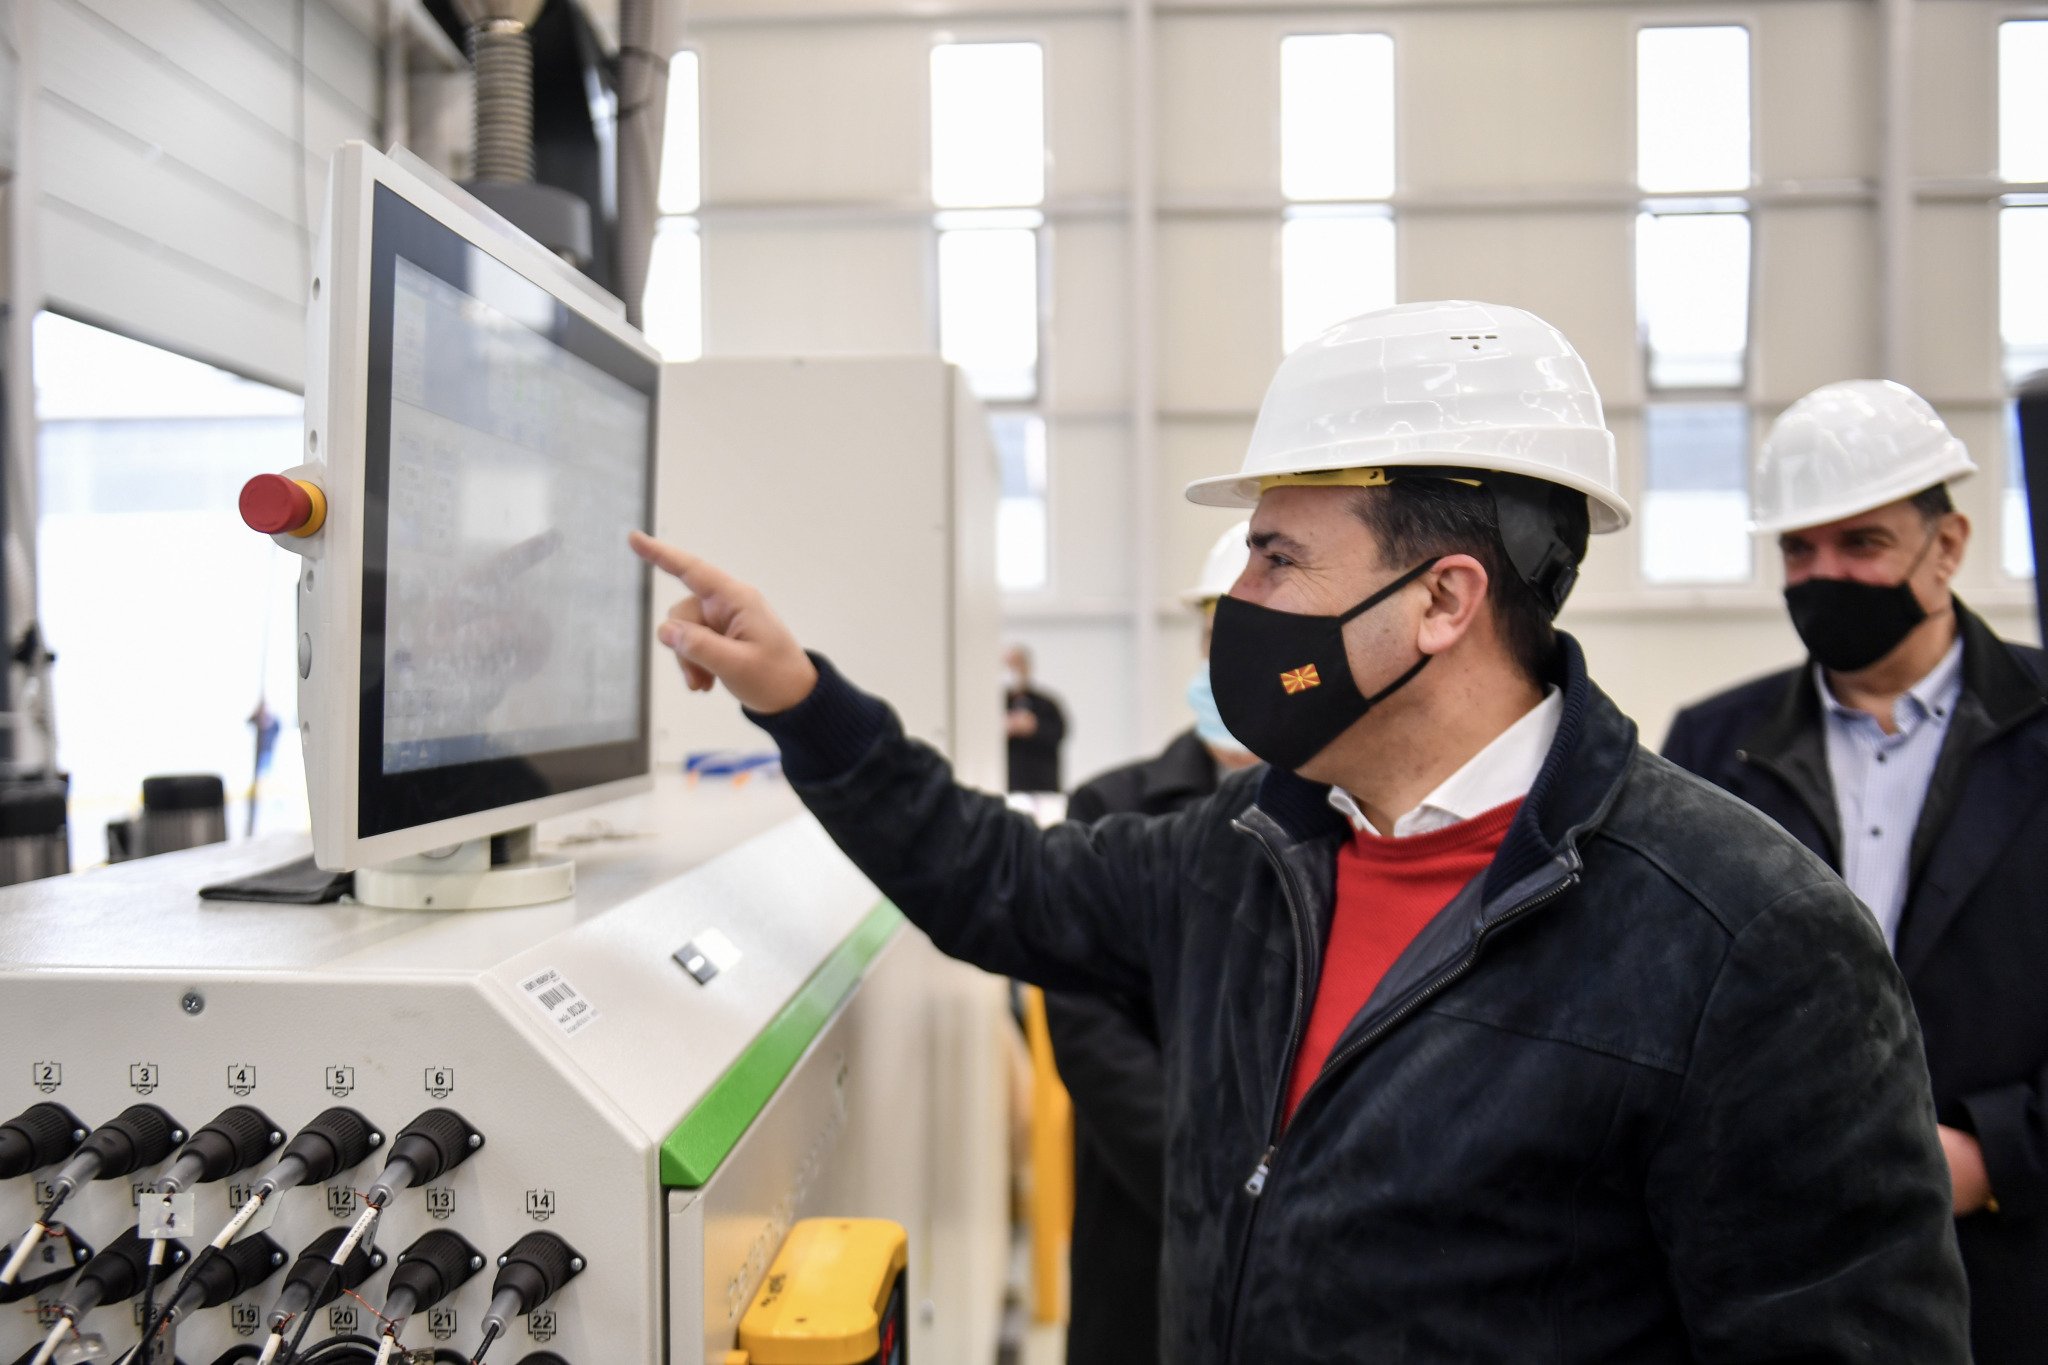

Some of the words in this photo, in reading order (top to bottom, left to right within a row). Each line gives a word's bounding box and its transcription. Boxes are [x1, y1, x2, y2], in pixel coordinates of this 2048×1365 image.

[43, 1066, 53, 1080] 2
[140, 1068, 150, 1082] 3
[236, 1069, 247, 1083] 4
[335, 1070, 345, 1084] 5
[434, 1071, 445, 1085] 6
[234, 1188, 251, 1203] 11
[332, 1190, 351, 1205] 12
[431, 1192, 450, 1207] 13
[531, 1194, 550, 1208] 14
[237, 1309, 256, 1323] 19
[333, 1310, 354, 1325] 20
[433, 1312, 451, 1327] 21
[532, 1314, 552, 1329] 22
